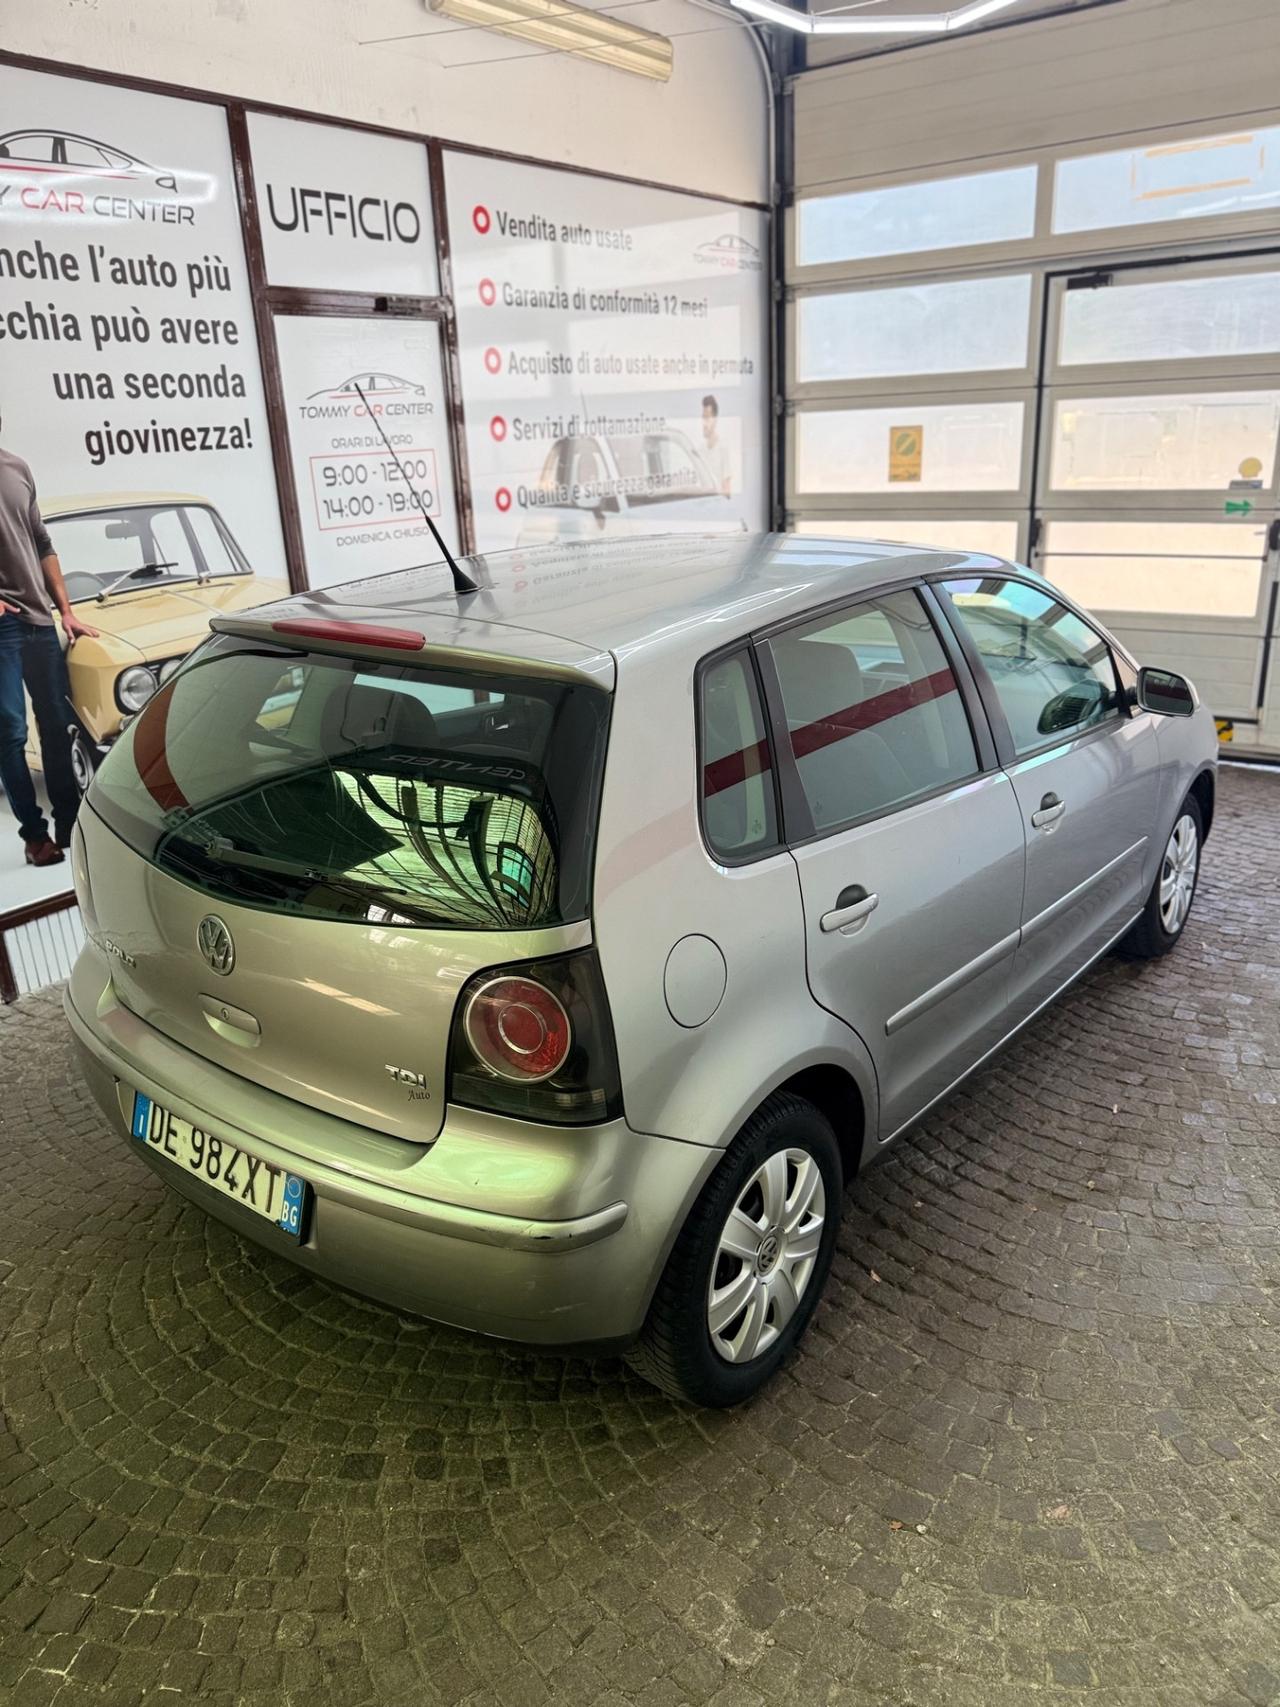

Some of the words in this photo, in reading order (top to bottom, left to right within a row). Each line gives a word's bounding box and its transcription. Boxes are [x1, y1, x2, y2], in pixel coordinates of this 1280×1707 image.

[20, 187, 85, 214] CAR
[93, 195, 195, 225] CENTER
[266, 184, 420, 243] UFFICIO
[496, 210, 556, 241] Vendita
[560, 222, 591, 245] auto
[595, 229, 633, 251] usate
[186, 255, 231, 298] più
[502, 281, 569, 310] Garanzia
[573, 287, 585, 311] di
[590, 289, 660, 315] conformità
[663, 295, 677, 315] 12
[681, 298, 708, 318] mesi
[90, 306, 150, 351] può
[160, 316, 239, 346] avere
[508, 350, 573, 380] Acquisto
[577, 352, 590, 375] di
[594, 355, 622, 375] auto
[626, 355, 660, 375] usate
[662, 354, 696, 375] anche
[699, 354, 709, 375] in
[53, 371, 114, 400] una
[124, 364, 246, 399] seconda
[299, 405, 350, 419] TOMMY
[353, 404, 383, 417] CAR
[385, 403, 433, 416] CENTER
[85, 417, 253, 466] giovinezza!
[513, 416, 563, 441] Servizi
[568, 415, 579, 437] di
[584, 413, 666, 437] rottamazione
[331, 437, 364, 449] ORARI
[365, 436, 375, 447] DI
[323, 464, 368, 487] 9:00
[380, 459, 427, 482] 12:00
[323, 495, 374, 519] 14:00
[387, 489, 433, 512] 19:00
[573, 484, 580, 499] e
[336, 533, 392, 547] DOMENICA
[393, 526, 429, 539] CHIUSO
[385, 1064, 427, 1090] TDI
[408, 1089, 431, 1101] Auto
[149, 1102, 181, 1157] DE
[189, 1125, 281, 1214] 984XT
[281, 1200, 298, 1227] BG
